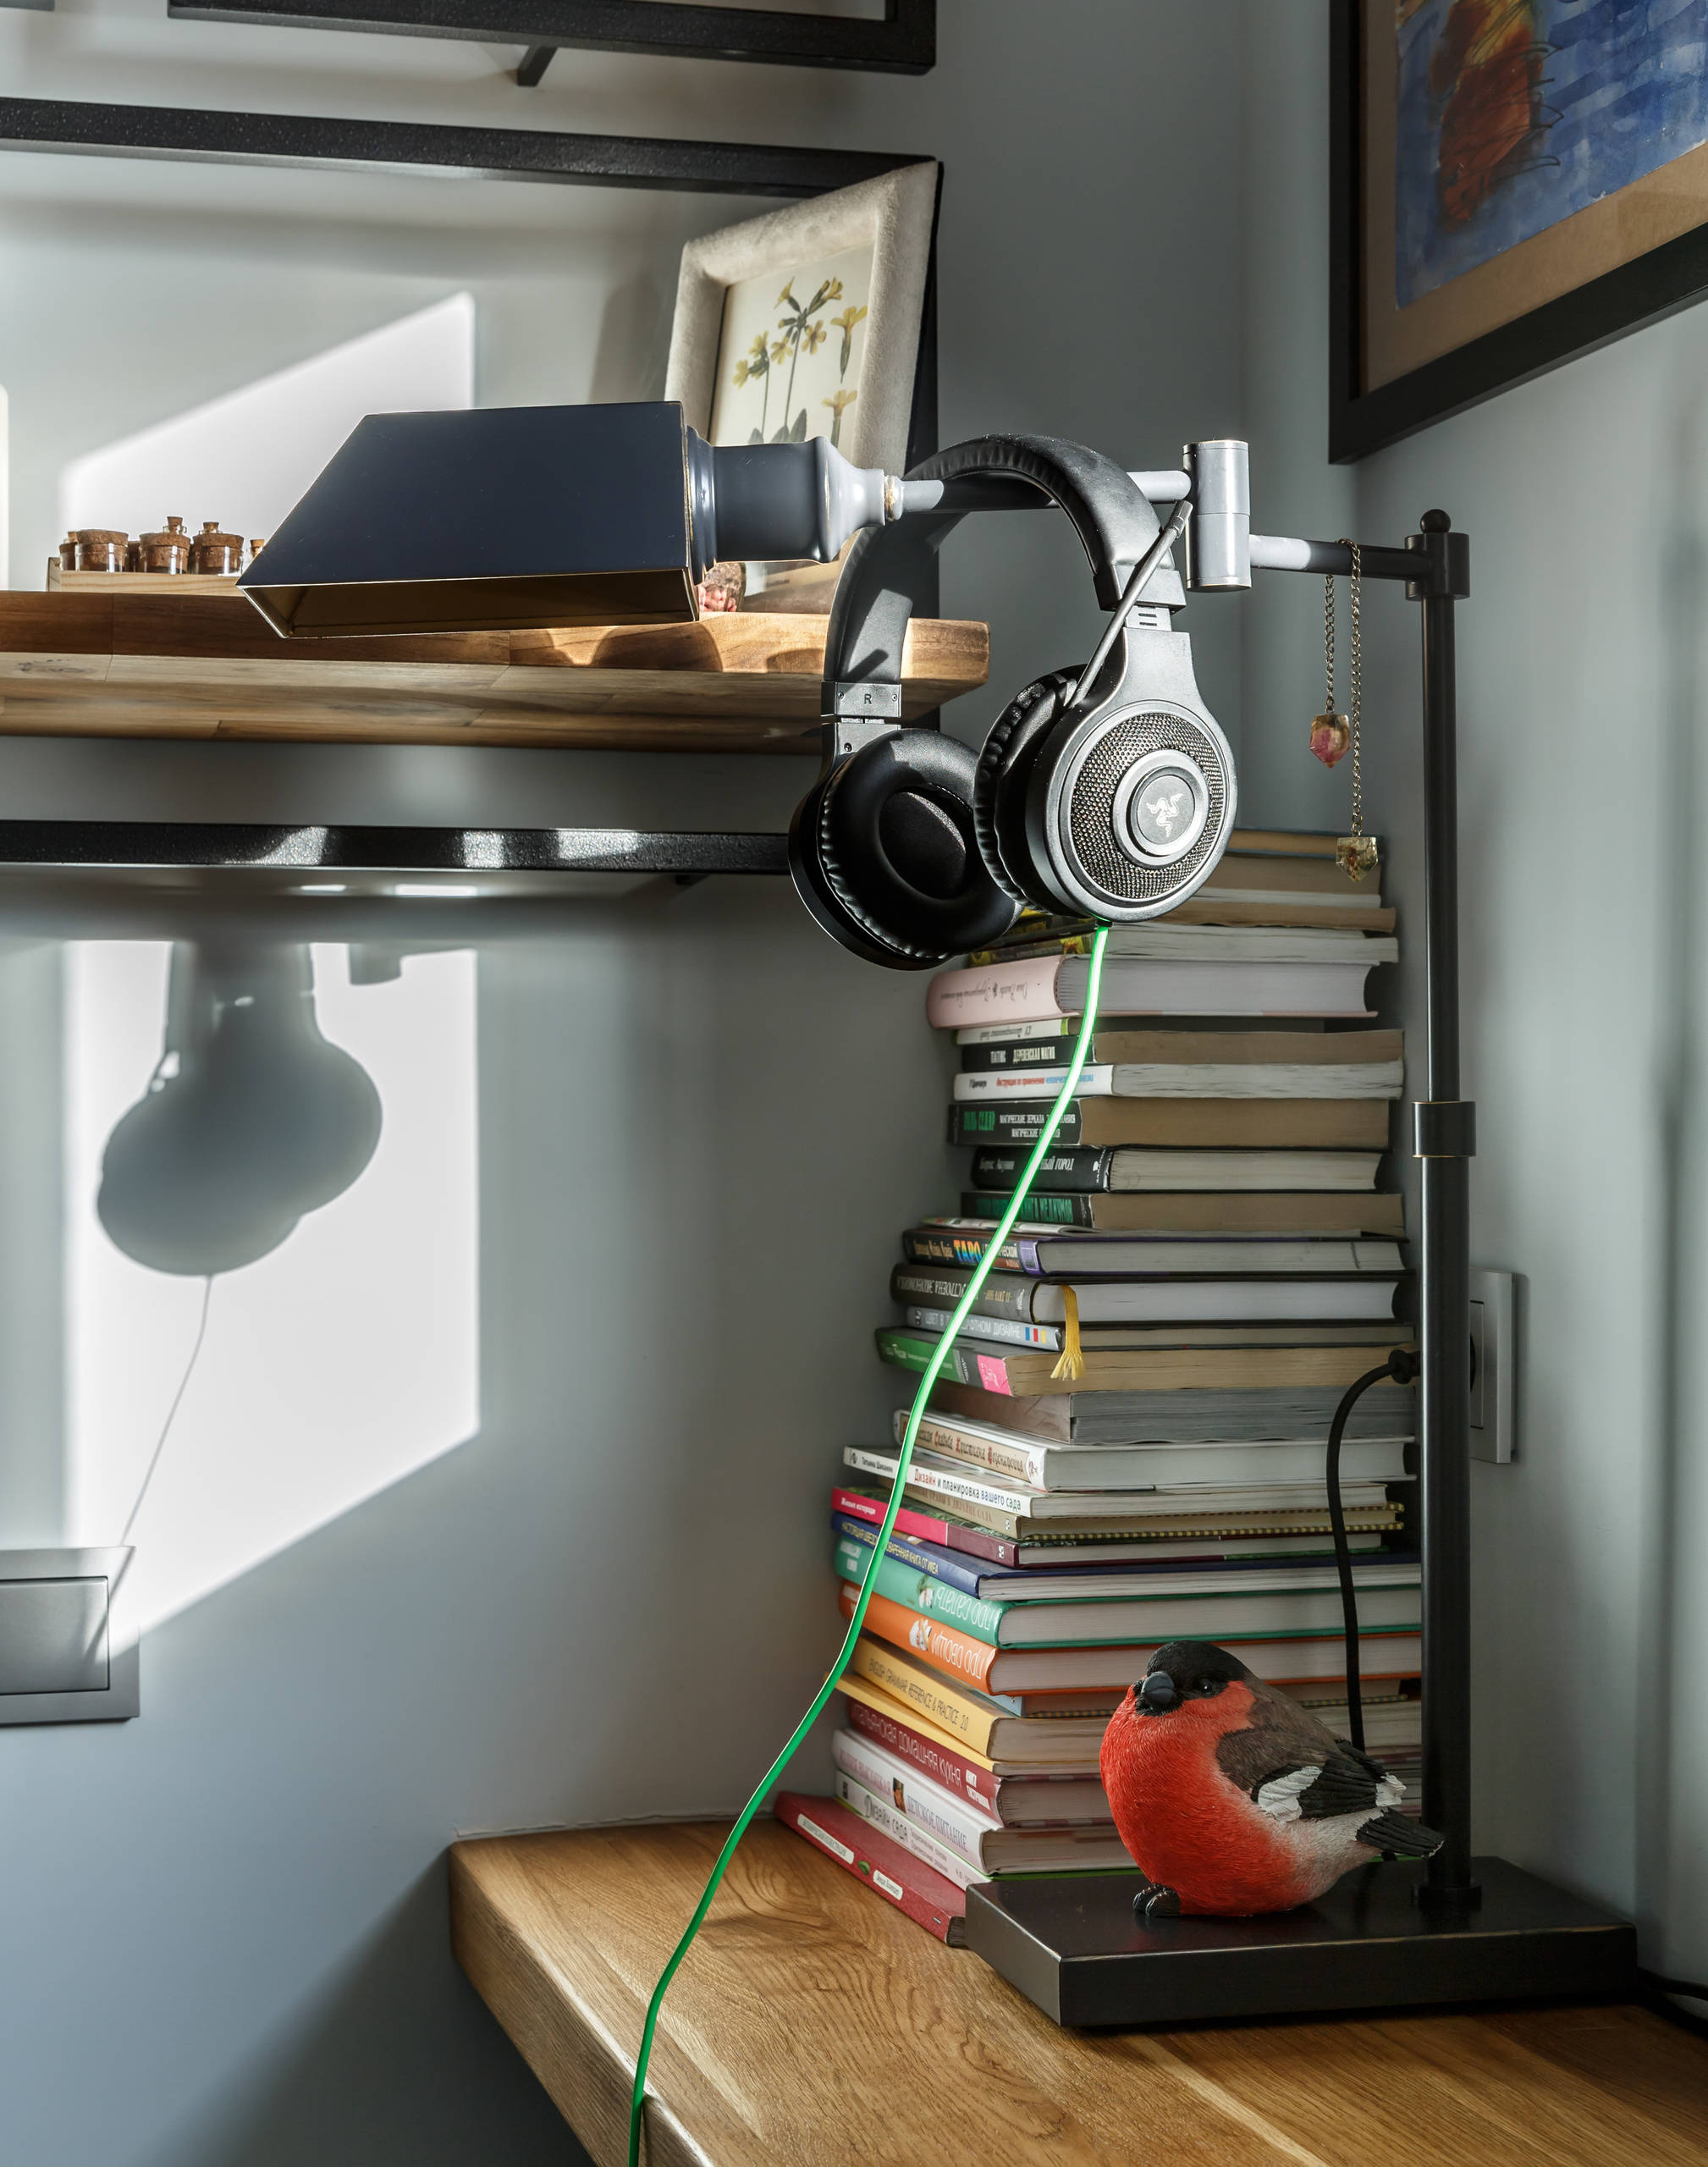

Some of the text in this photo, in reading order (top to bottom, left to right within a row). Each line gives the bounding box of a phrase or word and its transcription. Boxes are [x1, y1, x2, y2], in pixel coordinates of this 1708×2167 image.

[864, 694, 872, 704] R
[953, 1238, 983, 1263] ТАРО
[914, 1468, 936, 1485] Дизайн
[937, 1478, 941, 1487] и
[942, 1480, 980, 1499] планировка
[981, 1489, 1005, 1505] вашего
[1006, 1497, 1022, 1511] сада
[937, 1700, 960, 1725] PRACTICE
[907, 1795, 936, 1828] ДЕТСКОЕ
[935, 1816, 968, 1852] ПИТАНИЕ
